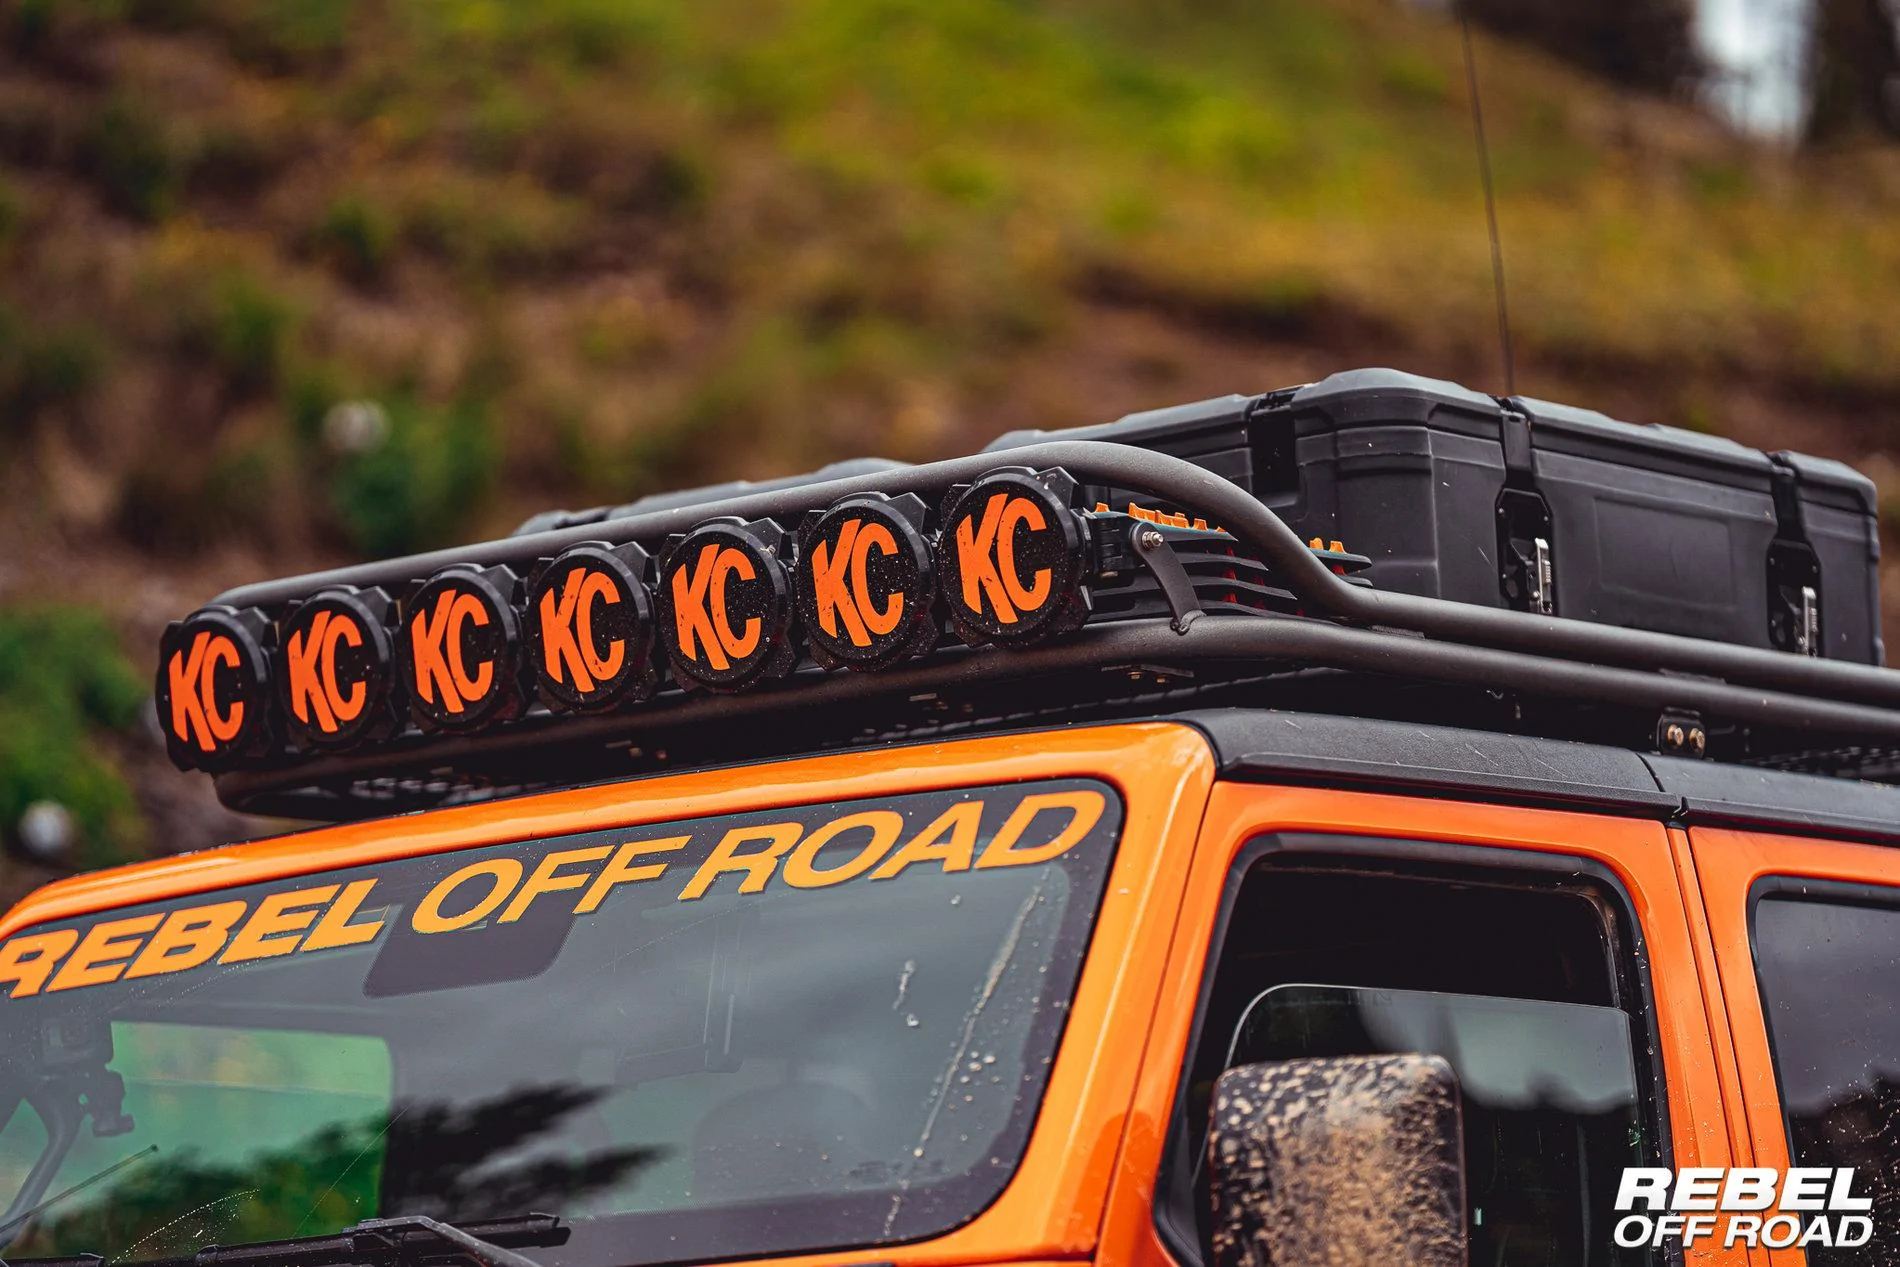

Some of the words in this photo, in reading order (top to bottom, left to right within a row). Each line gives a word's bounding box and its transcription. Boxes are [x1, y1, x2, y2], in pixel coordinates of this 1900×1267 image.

[671, 543, 762, 671] KC
[811, 519, 904, 647] KC
[956, 493, 1053, 624] KC
[169, 632, 244, 752] KC
[287, 610, 366, 734] KC
[411, 589, 494, 713] KC
[540, 567, 625, 693] KC
[0, 878, 385, 999] REBEL
[411, 835, 692, 934] OFF
[679, 790, 1106, 900] ROAD
